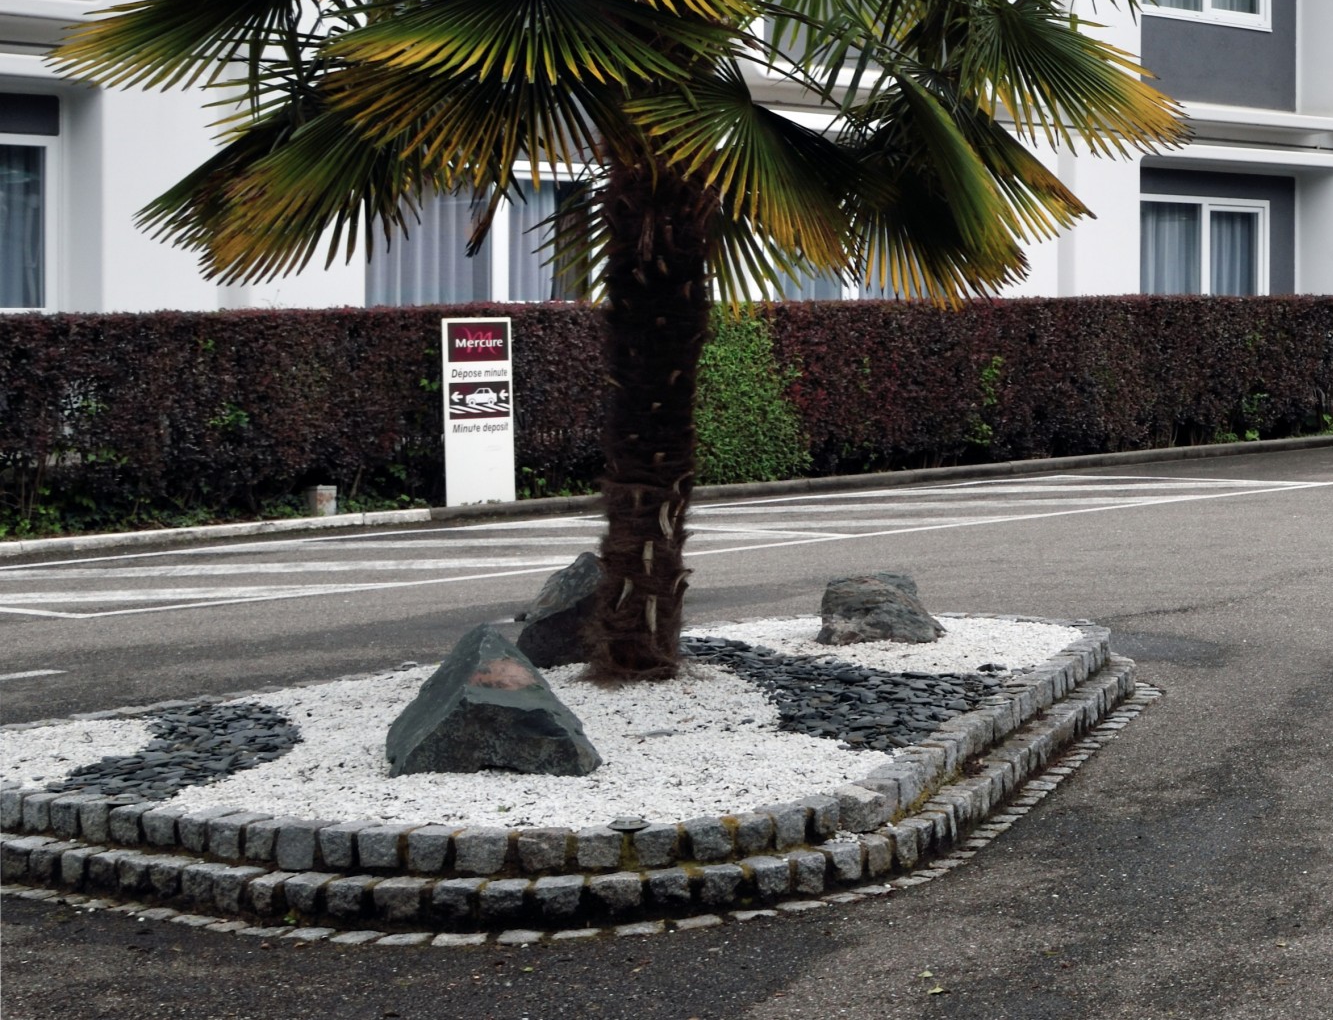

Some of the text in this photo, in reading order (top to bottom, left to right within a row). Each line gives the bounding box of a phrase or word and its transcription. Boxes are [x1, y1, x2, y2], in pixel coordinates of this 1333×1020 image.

[455, 338, 503, 348] Mercure
[451, 368, 508, 380] Dépose minute
[452, 422, 508, 434] Minute deposit
